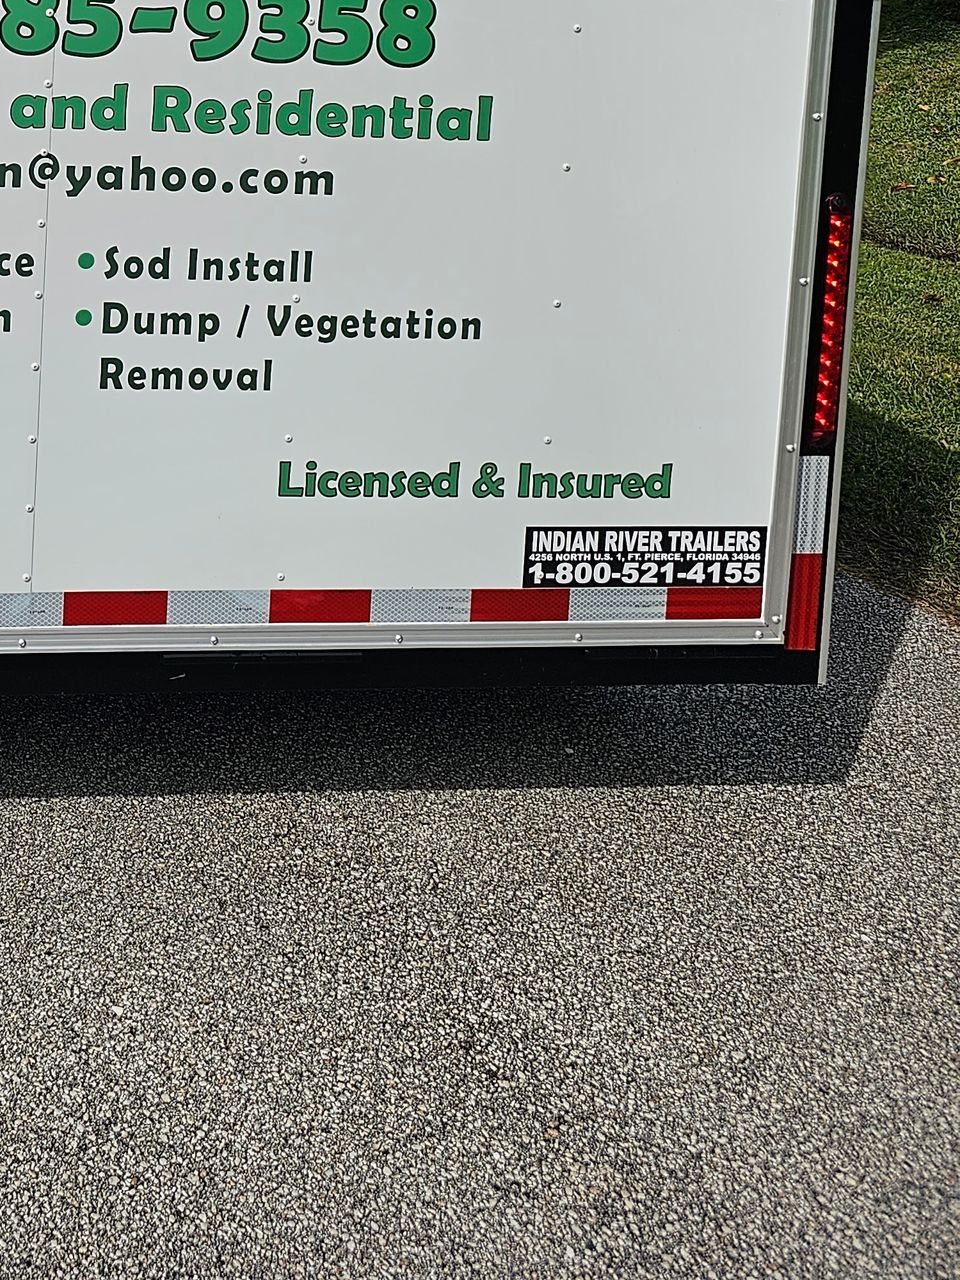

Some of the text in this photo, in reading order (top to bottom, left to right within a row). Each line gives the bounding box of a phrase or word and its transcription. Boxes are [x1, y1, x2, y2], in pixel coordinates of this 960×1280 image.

[10, 83, 129, 131] and
[152, 85, 493, 141] Residential
[104, 246, 314, 282] Sod Install
[102, 301, 482, 343] Dump / Vegetation
[99, 357, 273, 391] Removal
[278, 461, 673, 499] Licensed & Insured
[528, 553, 761, 562] 4256 NORTH U.S. 1, FT. PIERCE, FLORIDA 34946
[532, 531, 761, 552] INDIAN RIVER TRAILERS
[528, 562, 761, 584] 1-800-521-4155
